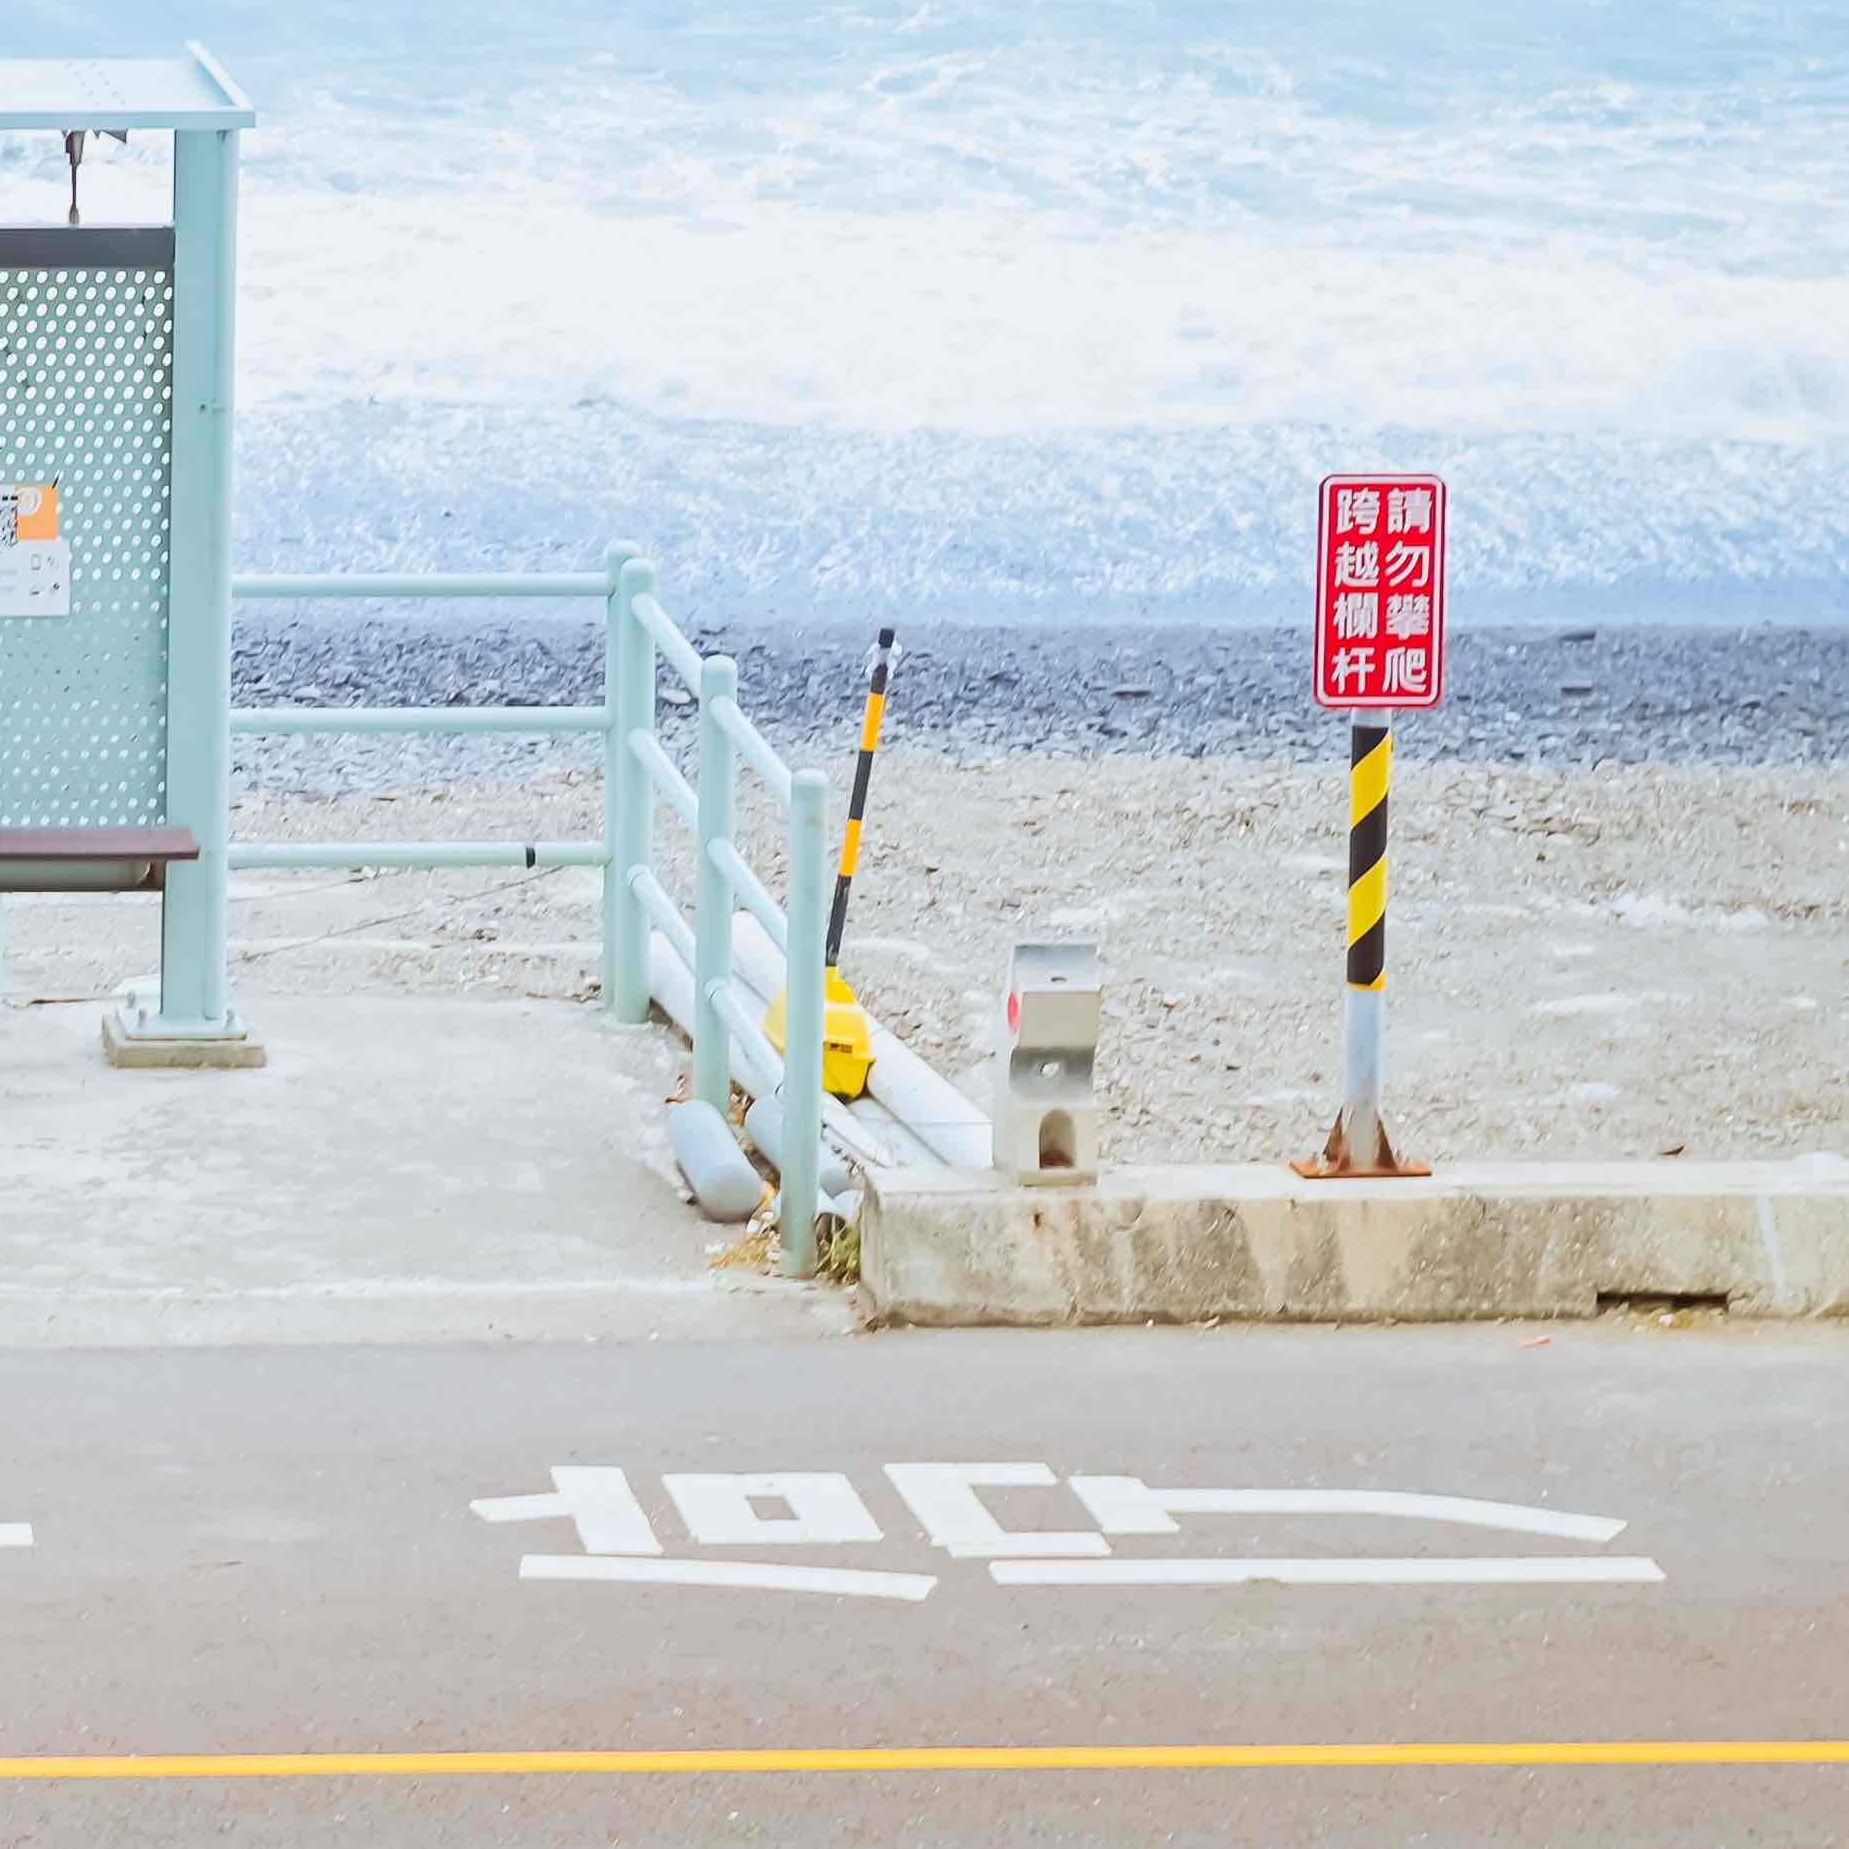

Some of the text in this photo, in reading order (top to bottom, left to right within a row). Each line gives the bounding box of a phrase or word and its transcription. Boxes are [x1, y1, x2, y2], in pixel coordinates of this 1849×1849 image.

[1331, 487, 1381, 694] 跨越欄杆
[1382, 487, 1433, 694] 請勿攀爬
